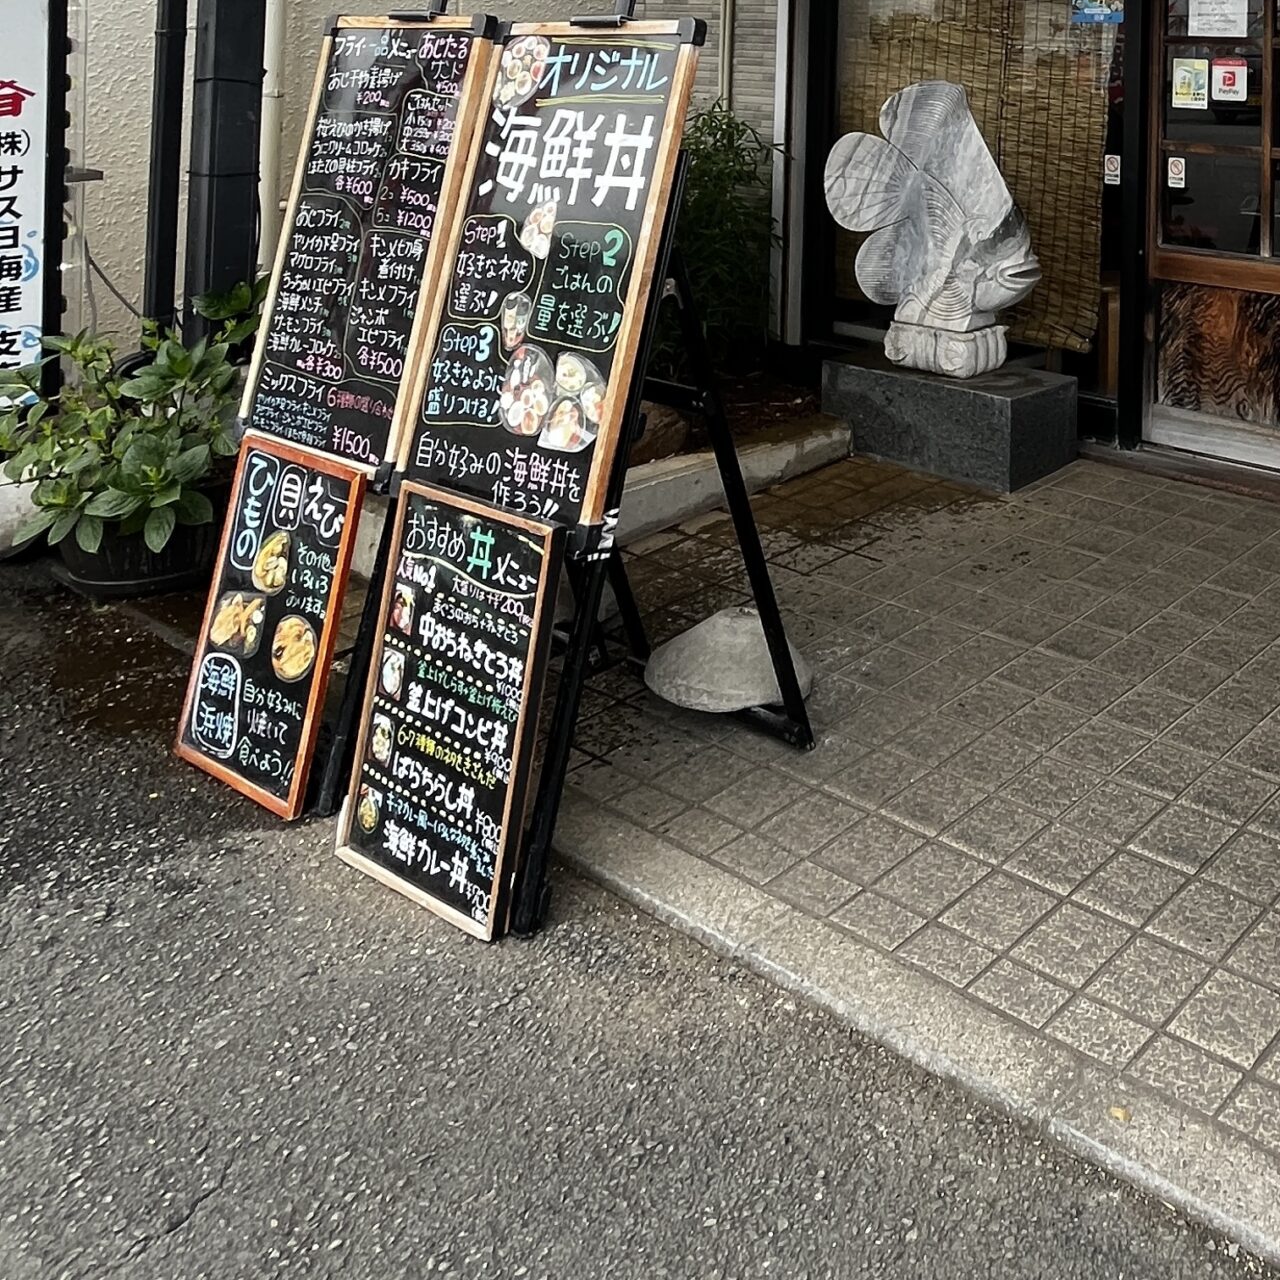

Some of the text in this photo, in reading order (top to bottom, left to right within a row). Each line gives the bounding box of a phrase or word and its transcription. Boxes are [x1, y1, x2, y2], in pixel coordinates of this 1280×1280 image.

[540, 44, 669, 98] オリジナル
[388, 158, 443, 183] カキフライ
[478, 105, 655, 211] 海鮮丼
[464, 219, 508, 249] Step1
[558, 229, 625, 268] Step2
[359, 278, 418, 309] キンメフライ
[551, 266, 613, 294] ごはんの
[356, 346, 403, 378] 各¥500
[442, 325, 495, 363] Step3
[260, 367, 326, 403] ミックスフライ
[332, 425, 370, 459] ¥1500
[415, 430, 581, 504] 自分好みの海鮮丼を
[236, 457, 275, 560] ひもの
[278, 472, 302, 521] 貝
[406, 512, 538, 591] おすすめ丼メニュー
[392, 750, 475, 820] ばらちらし丼
[382, 819, 470, 894] 海鮮カレー丼
